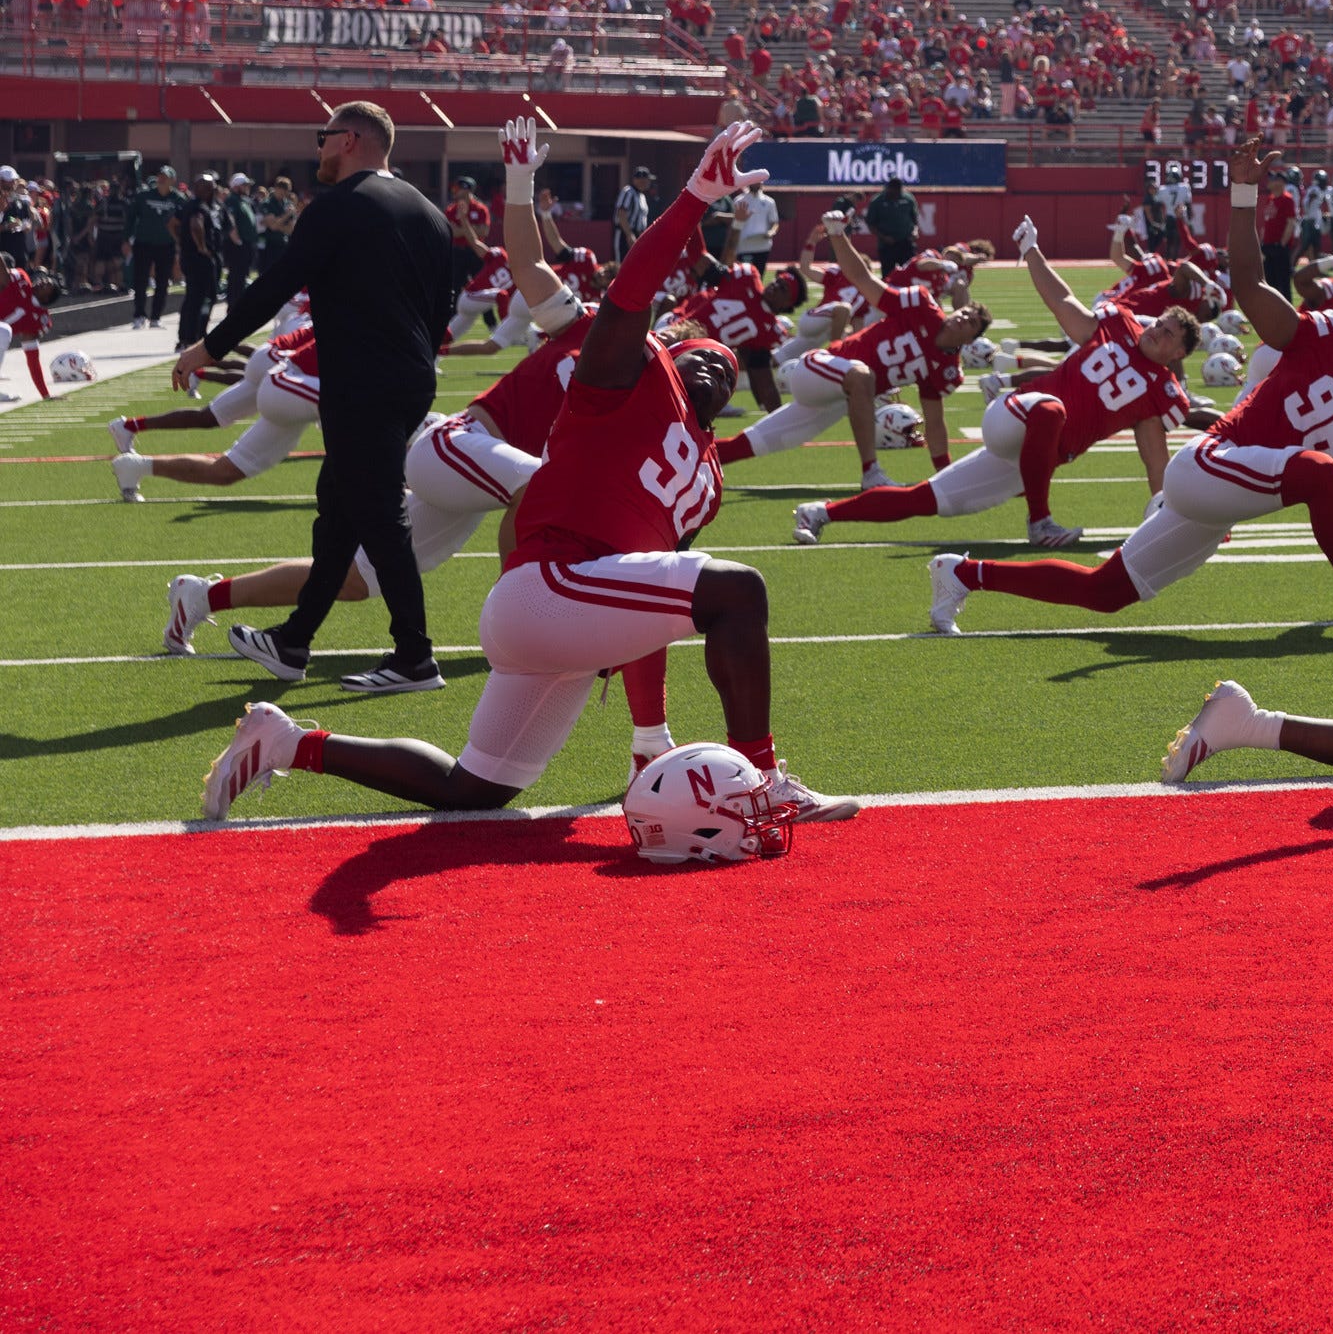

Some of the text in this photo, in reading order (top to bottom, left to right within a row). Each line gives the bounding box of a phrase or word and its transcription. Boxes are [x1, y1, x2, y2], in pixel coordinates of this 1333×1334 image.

[264, 7, 324, 44] THE
[502, 138, 530, 165] N
[828, 149, 920, 183] Modelo
[709, 298, 756, 348] 40
[877, 331, 929, 387] 55
[1080, 341, 1147, 411] 69
[639, 422, 715, 539] 90
[687, 764, 716, 803] N
